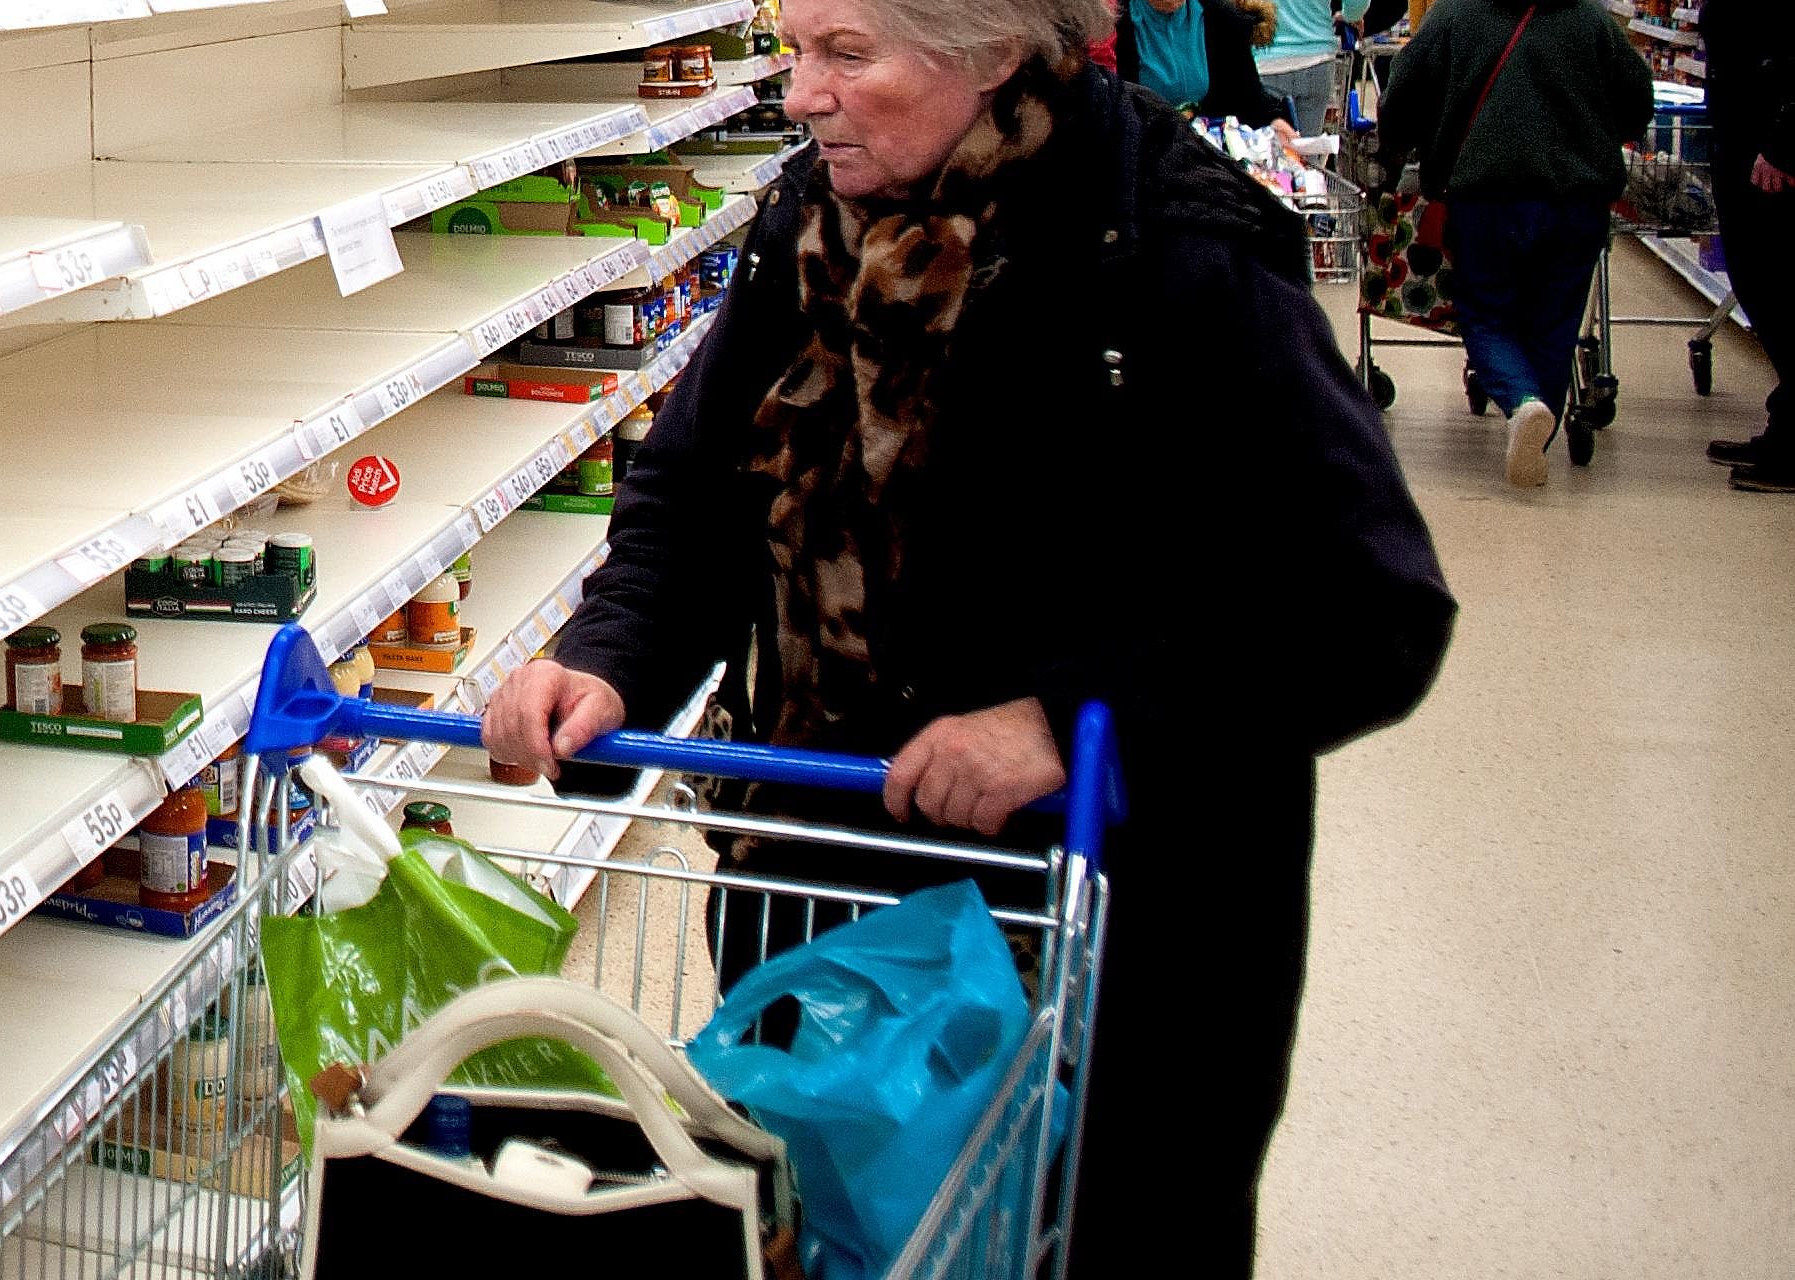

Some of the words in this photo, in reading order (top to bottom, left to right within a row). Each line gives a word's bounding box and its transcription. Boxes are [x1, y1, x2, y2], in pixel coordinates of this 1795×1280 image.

[56, 250, 95, 290] 53p
[565, 351, 595, 362] TESCO
[386, 380, 411, 409] 53p
[330, 414, 351, 443] £1
[239, 460, 273, 494] 53p
[185, 492, 211, 527] £1
[81, 538, 127, 571] 55p
[30, 720, 63, 735] TESCO
[187, 731, 207, 761] £1
[83, 801, 123, 846] 55p
